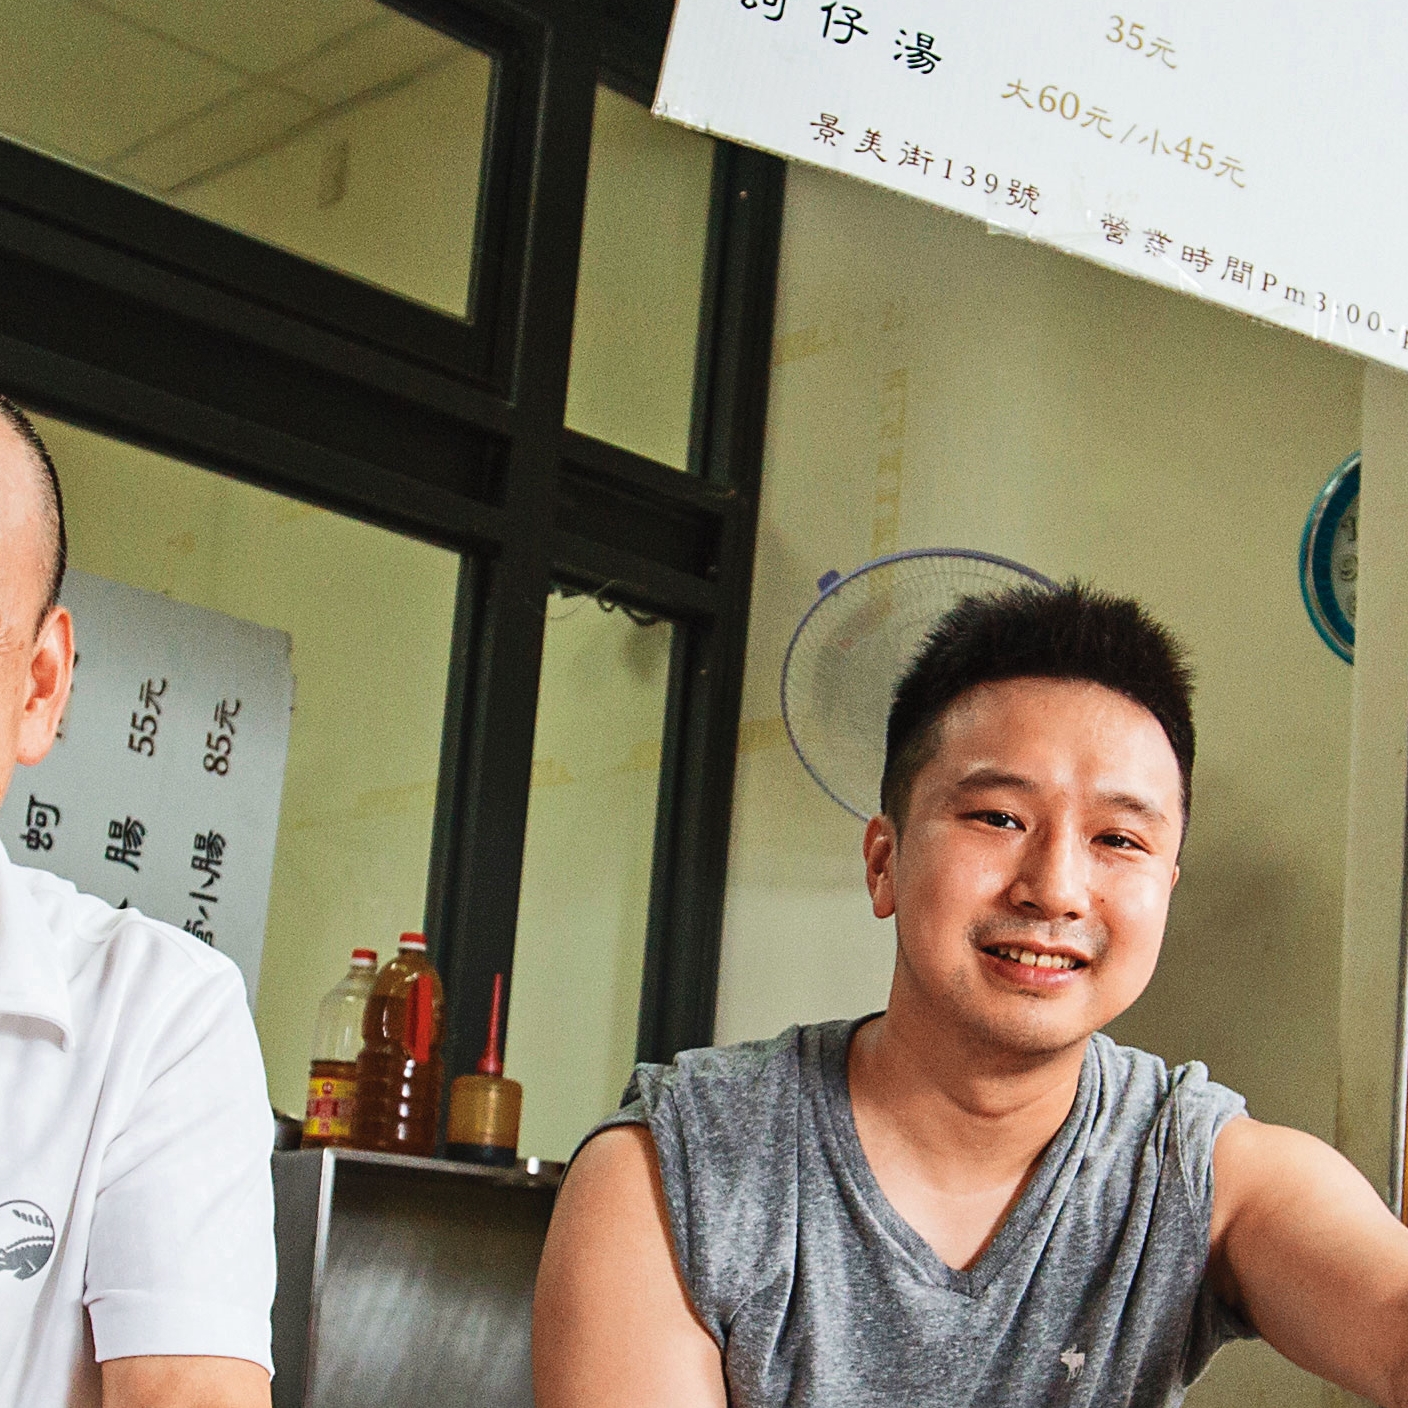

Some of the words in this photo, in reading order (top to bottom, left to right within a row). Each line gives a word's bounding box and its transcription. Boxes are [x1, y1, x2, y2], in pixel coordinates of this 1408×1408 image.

[1106, 15, 1177, 69] 35元
[810, 112, 1041, 216] 景美街139號
[1001, 79, 1245, 188] 大60元/小45元
[127, 677, 168, 757] 55元
[202, 698, 242, 776] 85元
